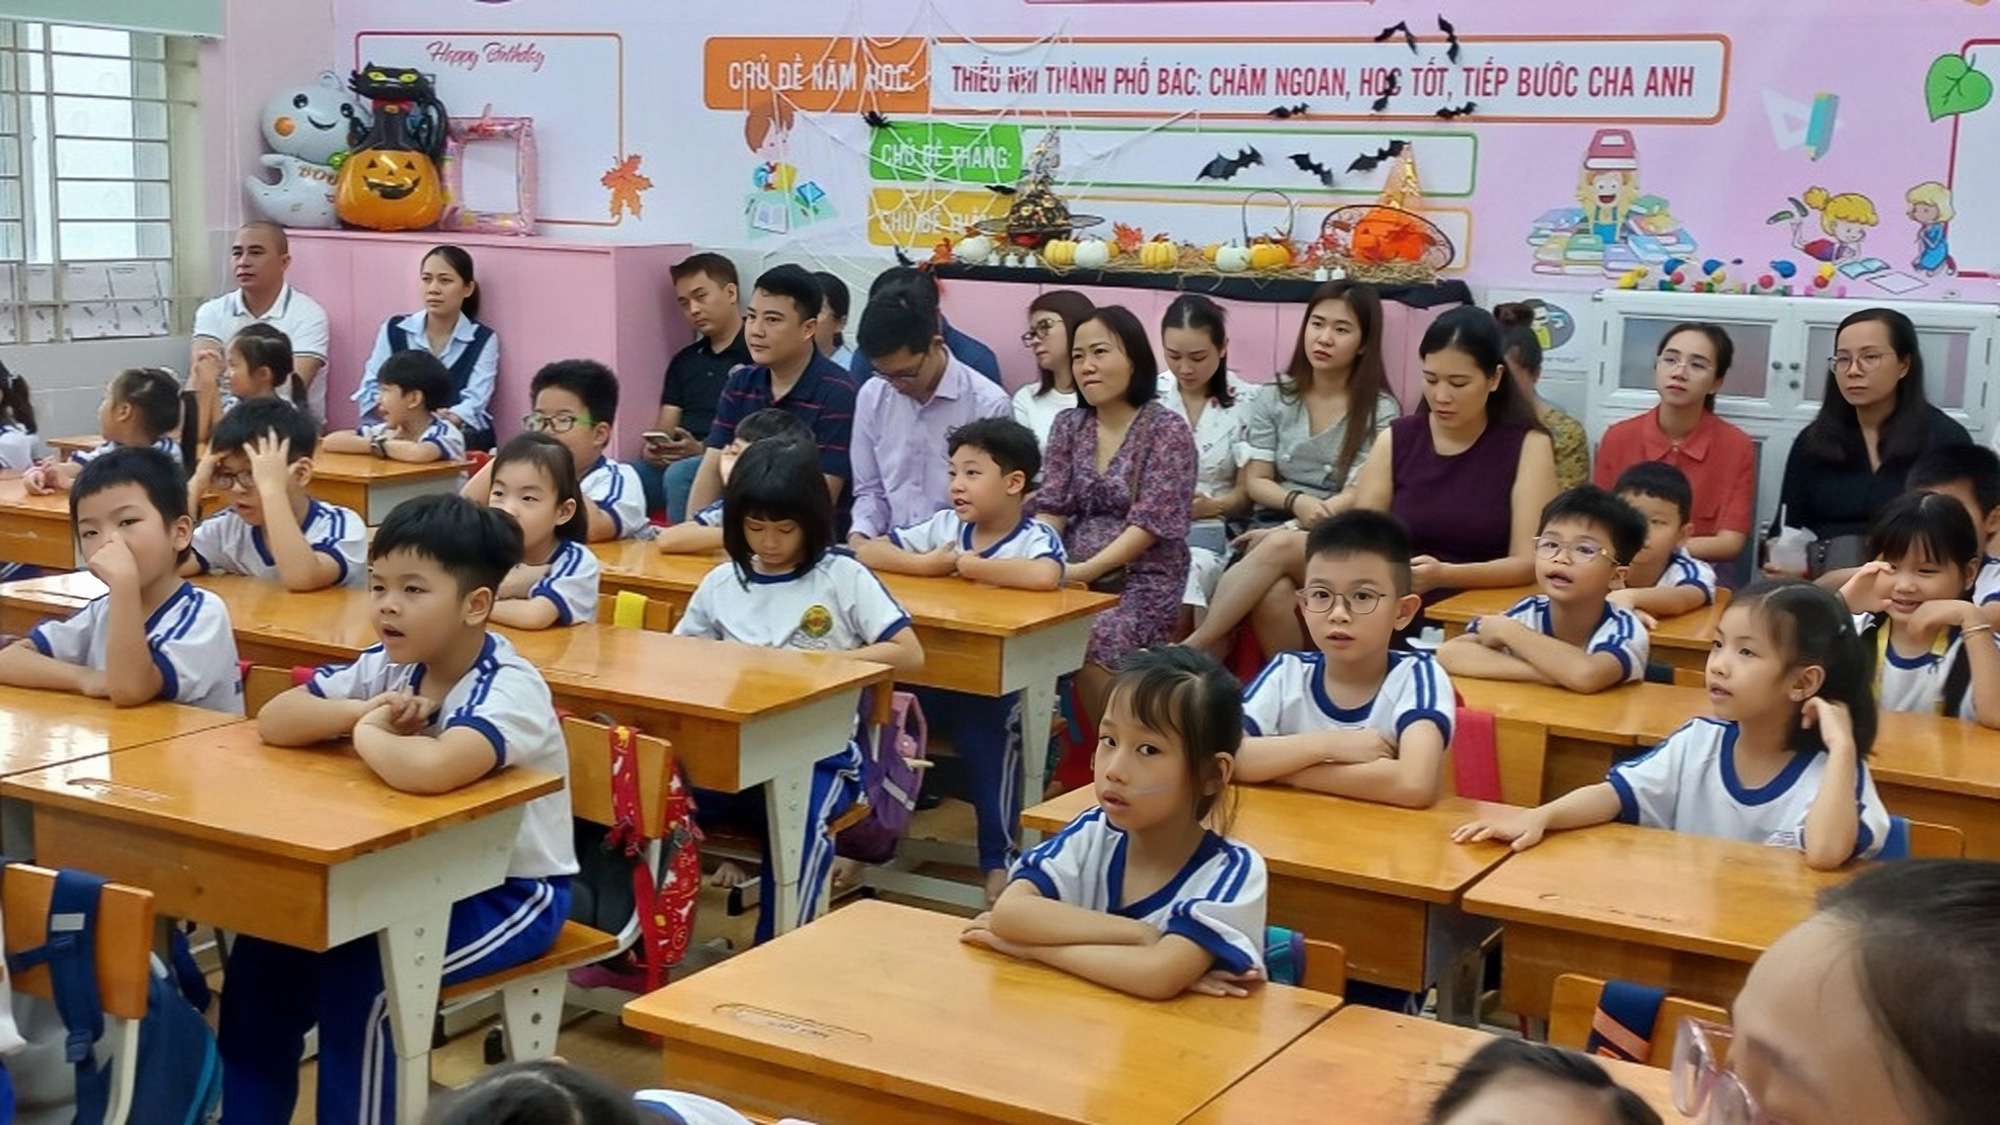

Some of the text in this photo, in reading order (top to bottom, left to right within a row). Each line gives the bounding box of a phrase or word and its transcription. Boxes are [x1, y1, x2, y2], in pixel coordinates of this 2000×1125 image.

[426, 41, 545, 72] Happy Birthday
[729, 54, 770, 90] CHỦ
[778, 53, 804, 91] ĐỀ
[812, 58, 857, 91] NĂM
[952, 56, 1001, 93] THIẾU
[1045, 61, 1106, 95] THÀNH
[1113, 57, 1150, 96] PHỐ
[1157, 61, 1201, 96] BÁC:
[1209, 64, 1267, 97] CHĂM
[1275, 67, 1350, 101] NGOAN,
[1412, 57, 1452, 100] TỐT,
[1463, 57, 1509, 97] TIẾP
[1517, 60, 1579, 97] BƯỚC
[1588, 66, 1634, 97] CHA
[1644, 66, 1694, 97] ANH
